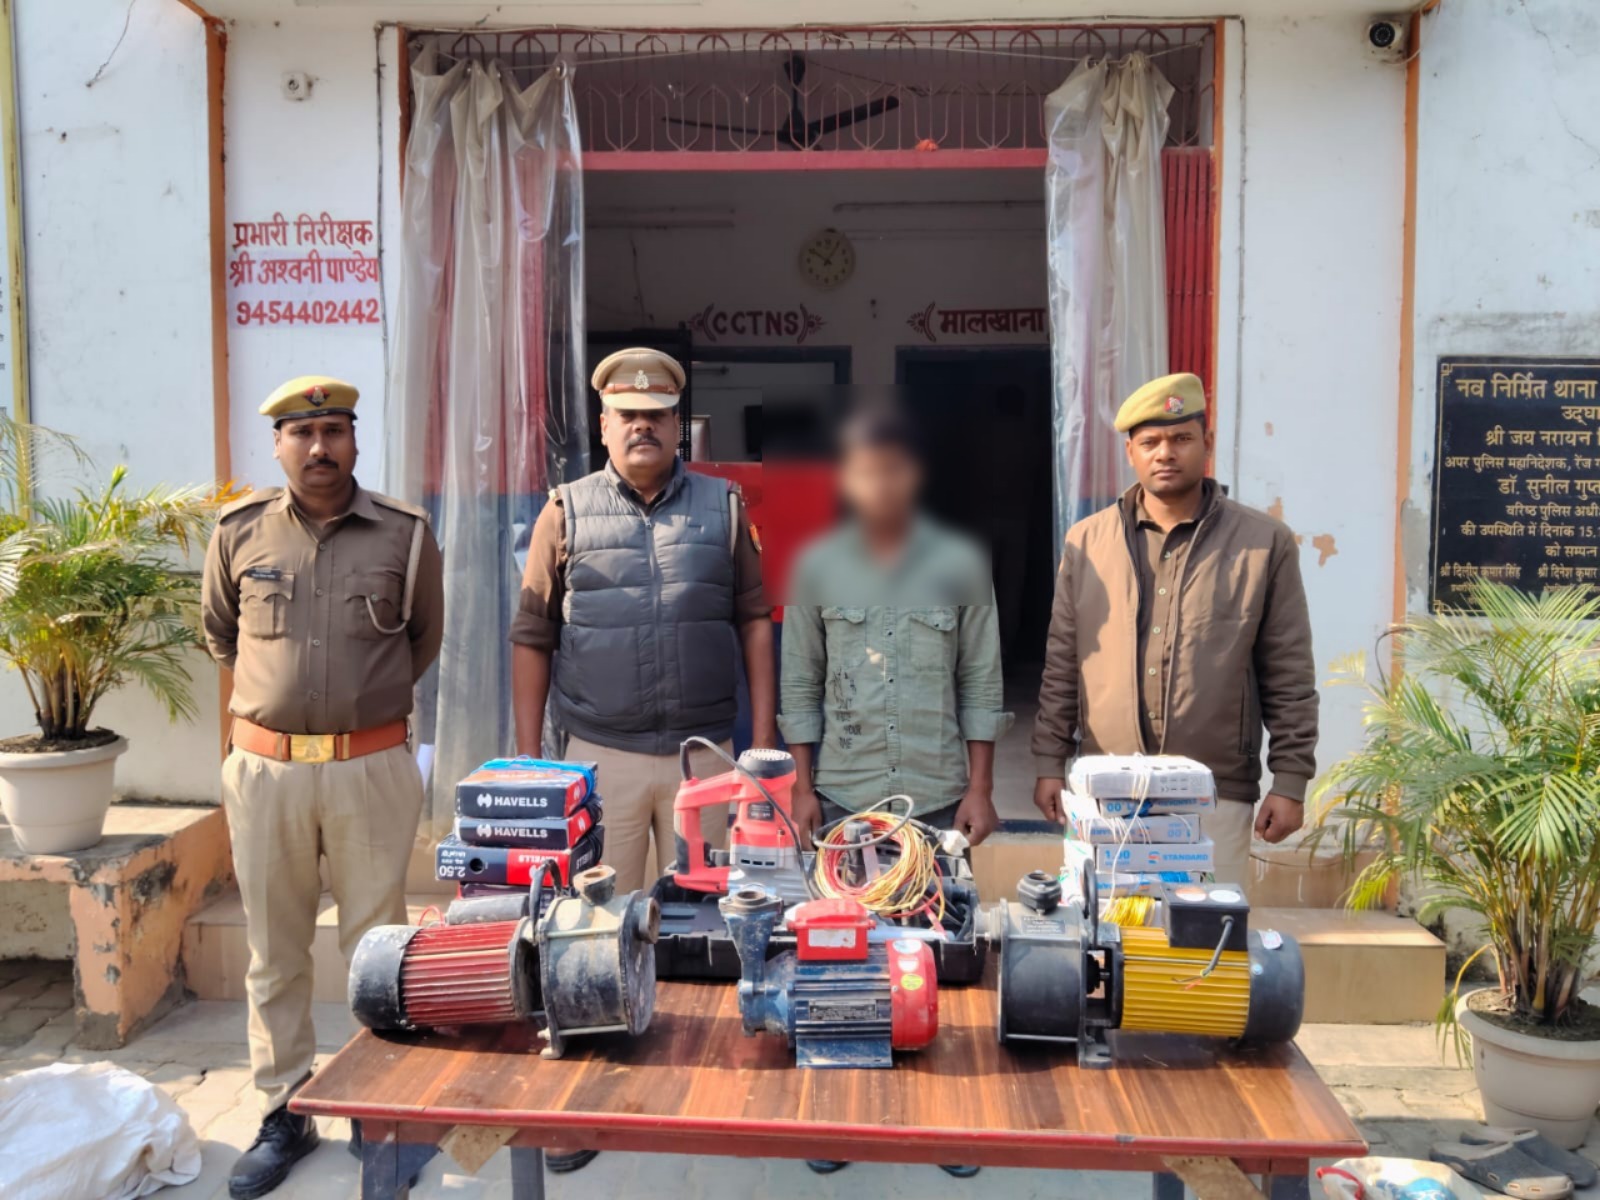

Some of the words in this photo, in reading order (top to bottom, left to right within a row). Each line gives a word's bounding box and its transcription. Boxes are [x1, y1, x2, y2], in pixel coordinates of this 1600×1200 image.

[232, 211, 289, 250] प्रभारी
[293, 211, 373, 250] निरीक्षक
[229, 250, 256, 288] श्री
[258, 249, 323, 285] अश्वनी
[325, 250, 379, 283] पाण्डेय
[236, 298, 380, 326] 9454402442
[937, 308, 1047, 334] मालखाना
[712, 310, 799, 336] CCTNS
[1455, 379, 1486, 398] नव
[1491, 372, 1548, 399] निर्मित
[1554, 379, 1598, 399] थाना
[1486, 425, 1505, 446] श्री
[1508, 430, 1536, 446] जय
[1539, 430, 1593, 447] नरायन
[1444, 456, 1470, 468] अपर
[1472, 453, 1505, 473] पुलिस
[1526, 473, 1571, 500] सुनील
[1505, 501, 1538, 517] वरिष्ठ
[1540, 502, 1571, 520] पुलिस
[1574, 502, 1600, 517] अधी
[1460, 520, 1477, 536] की
[1479, 520, 1525, 537] उपस्थिति
[1540, 522, 1575, 538] दिनांक
[1545, 541, 1561, 557] को
[494, 796, 548, 808] HAVELLS
[494, 827, 548, 838] HAVELLS
[1163, 853, 1208, 861] STANDARD
[439, 866, 466, 878] 2.50
